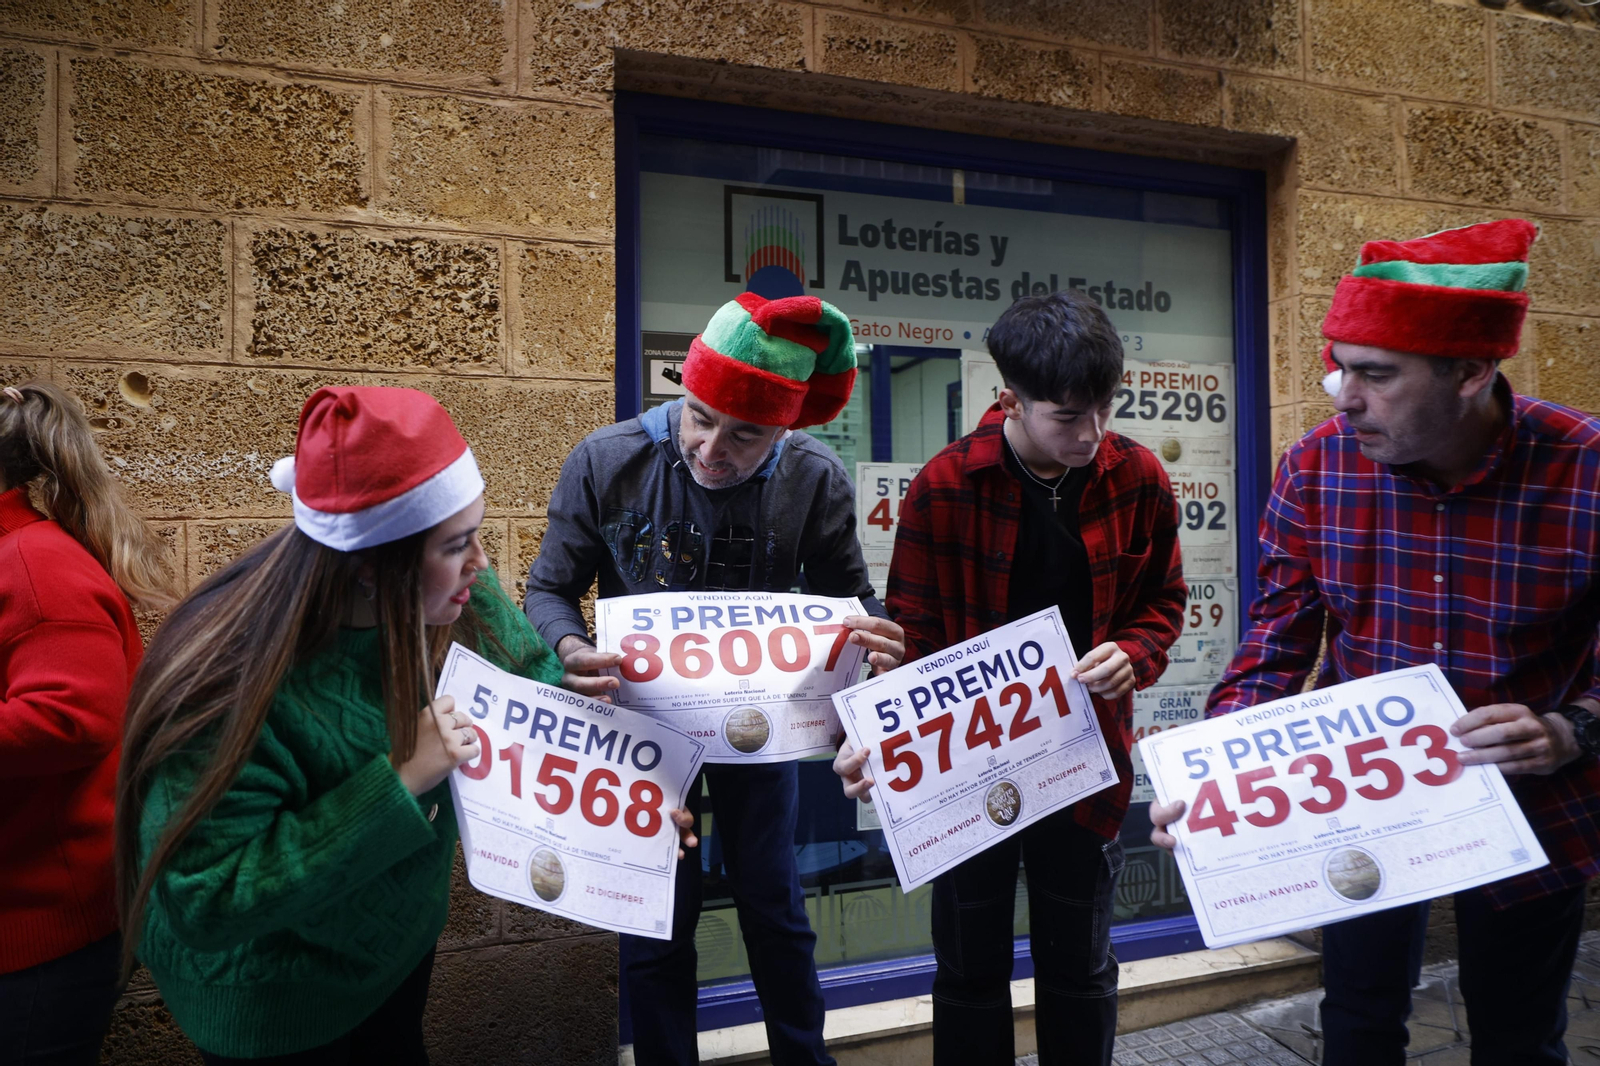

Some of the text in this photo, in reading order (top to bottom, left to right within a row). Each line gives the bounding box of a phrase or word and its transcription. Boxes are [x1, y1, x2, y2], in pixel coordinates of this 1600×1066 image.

[838, 213, 1009, 267] Loterías y
[839, 259, 1001, 302] Apuestas
[1011, 271, 1059, 302] del
[898, 321, 954, 344] Negro
[1134, 335, 1143, 351] 3
[1140, 371, 1219, 392] PREMIO
[1114, 388, 1227, 423] 25296
[670, 604, 834, 630] PREMIO
[618, 623, 854, 683] 86007
[917, 637, 990, 675] VENDIDO AQUÍ
[908, 640, 1044, 720] PREMIO
[536, 686, 616, 718] VENDIDO AQUÍ
[723, 696, 746, 704] SUERTE
[1153, 708, 1199, 721] PREMIO
[1159, 697, 1191, 709] GRAN
[1236, 693, 1334, 727] VENDIDO AQUÍ
[503, 698, 662, 771] PREMIO
[796, 719, 826, 729] DICIEMBRE
[880, 665, 1071, 792] 57421
[1222, 695, 1415, 770] PREMIO
[458, 724, 664, 838] 01568
[948, 791, 959, 800] HAY
[959, 782, 978, 794] MAYOR
[978, 773, 998, 785] SUERTE
[998, 767, 1008, 776] QUE
[1023, 748, 1048, 763] TENERNOS
[1038, 762, 1087, 789] 22 DICIEMBRE
[1186, 724, 1464, 838] 45353
[492, 816, 501, 824] NO
[502, 820, 513, 828] HAY
[515, 825, 533, 835] MAYOR
[908, 835, 939, 857] LOTERÍA
[947, 814, 981, 837] NAVIDAD
[480, 849, 519, 869] NAVIDAD
[1270, 851, 1285, 859] HAY
[1286, 844, 1313, 855] MAYOR
[1314, 837, 1342, 848] SUERTE
[1343, 832, 1359, 841] QUE
[1408, 838, 1488, 866] 22 DICIEMBRE
[586, 885, 644, 905] 22 DICIEMBRE
[1214, 892, 1257, 910] LOTERÍA
[1268, 880, 1318, 898] NAVIDAD
